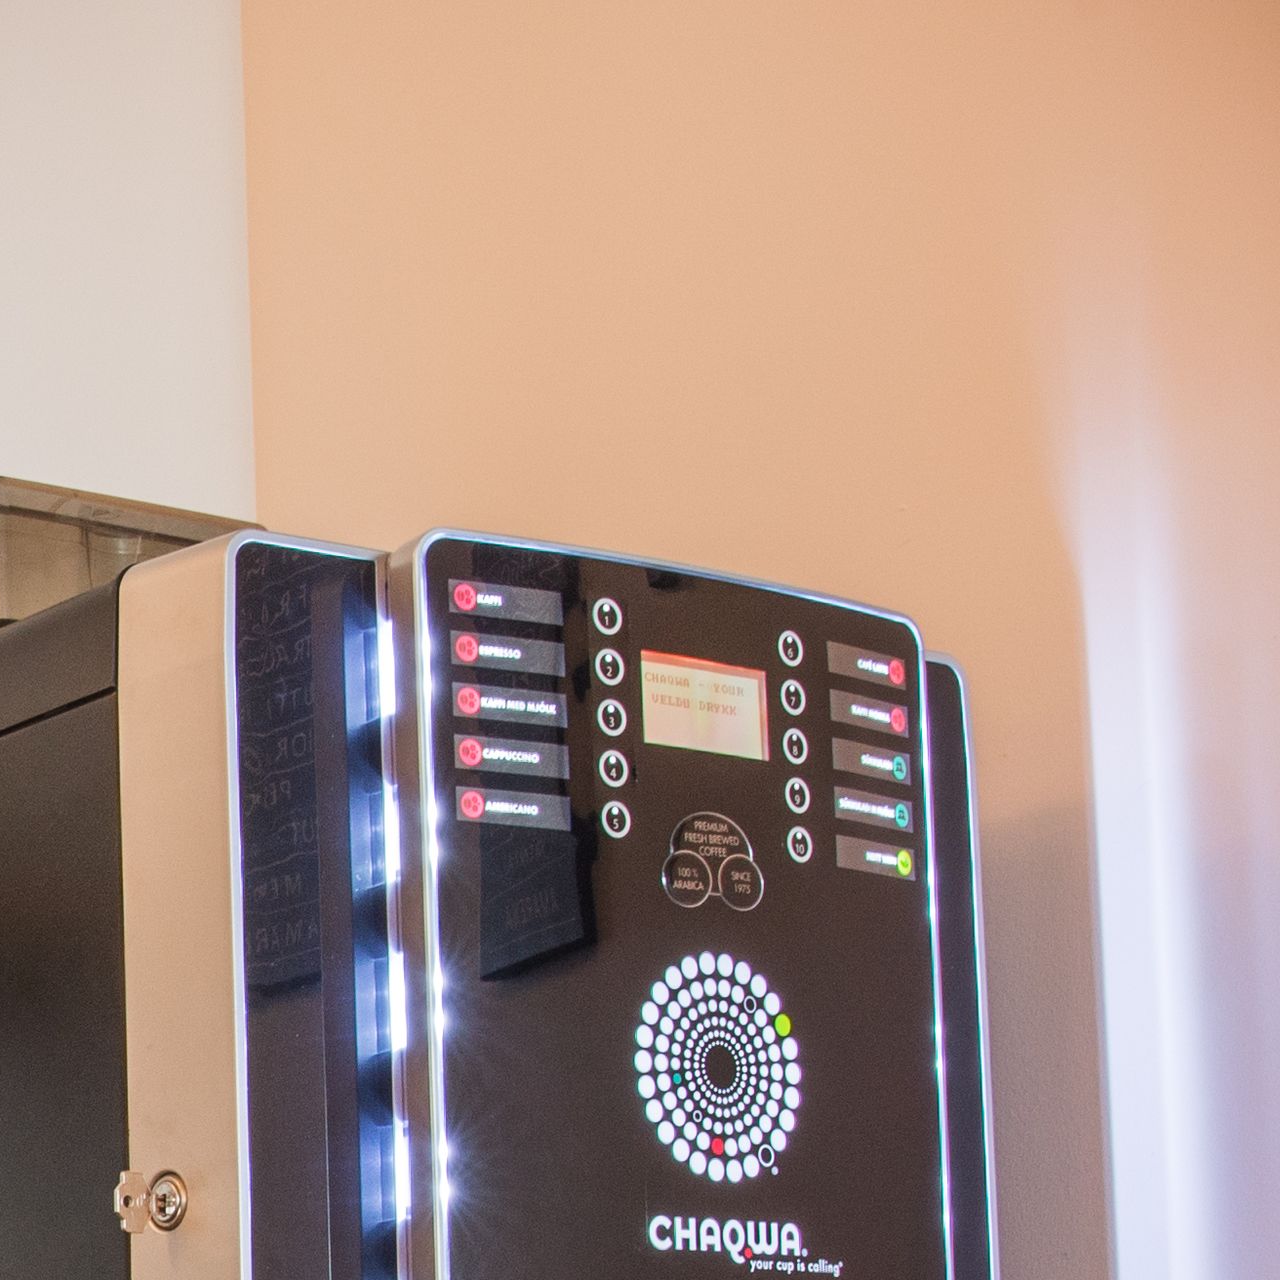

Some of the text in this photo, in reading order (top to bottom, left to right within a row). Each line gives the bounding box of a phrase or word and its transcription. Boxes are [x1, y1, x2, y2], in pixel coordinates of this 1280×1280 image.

[604, 616, 610, 626] 1
[478, 644, 522, 660] ESPRESSO
[606, 666, 613, 677] 2
[609, 716, 615, 728] 3
[482, 748, 540, 764] CAPPUCCINO
[792, 746, 798, 756] 8
[610, 767, 617, 779] 4
[794, 794, 801, 804] 9
[485, 801, 539, 815] AMERICANO
[613, 819, 619, 830] 5
[694, 821, 728, 832] PREMIUM
[684, 832, 739, 846] FRESH BREWED
[699, 846, 727, 857] COFFEE
[796, 843, 805, 854] 10
[672, 880, 705, 890] ARABICA
[749, 1259, 840, 1277] your cup is calling
